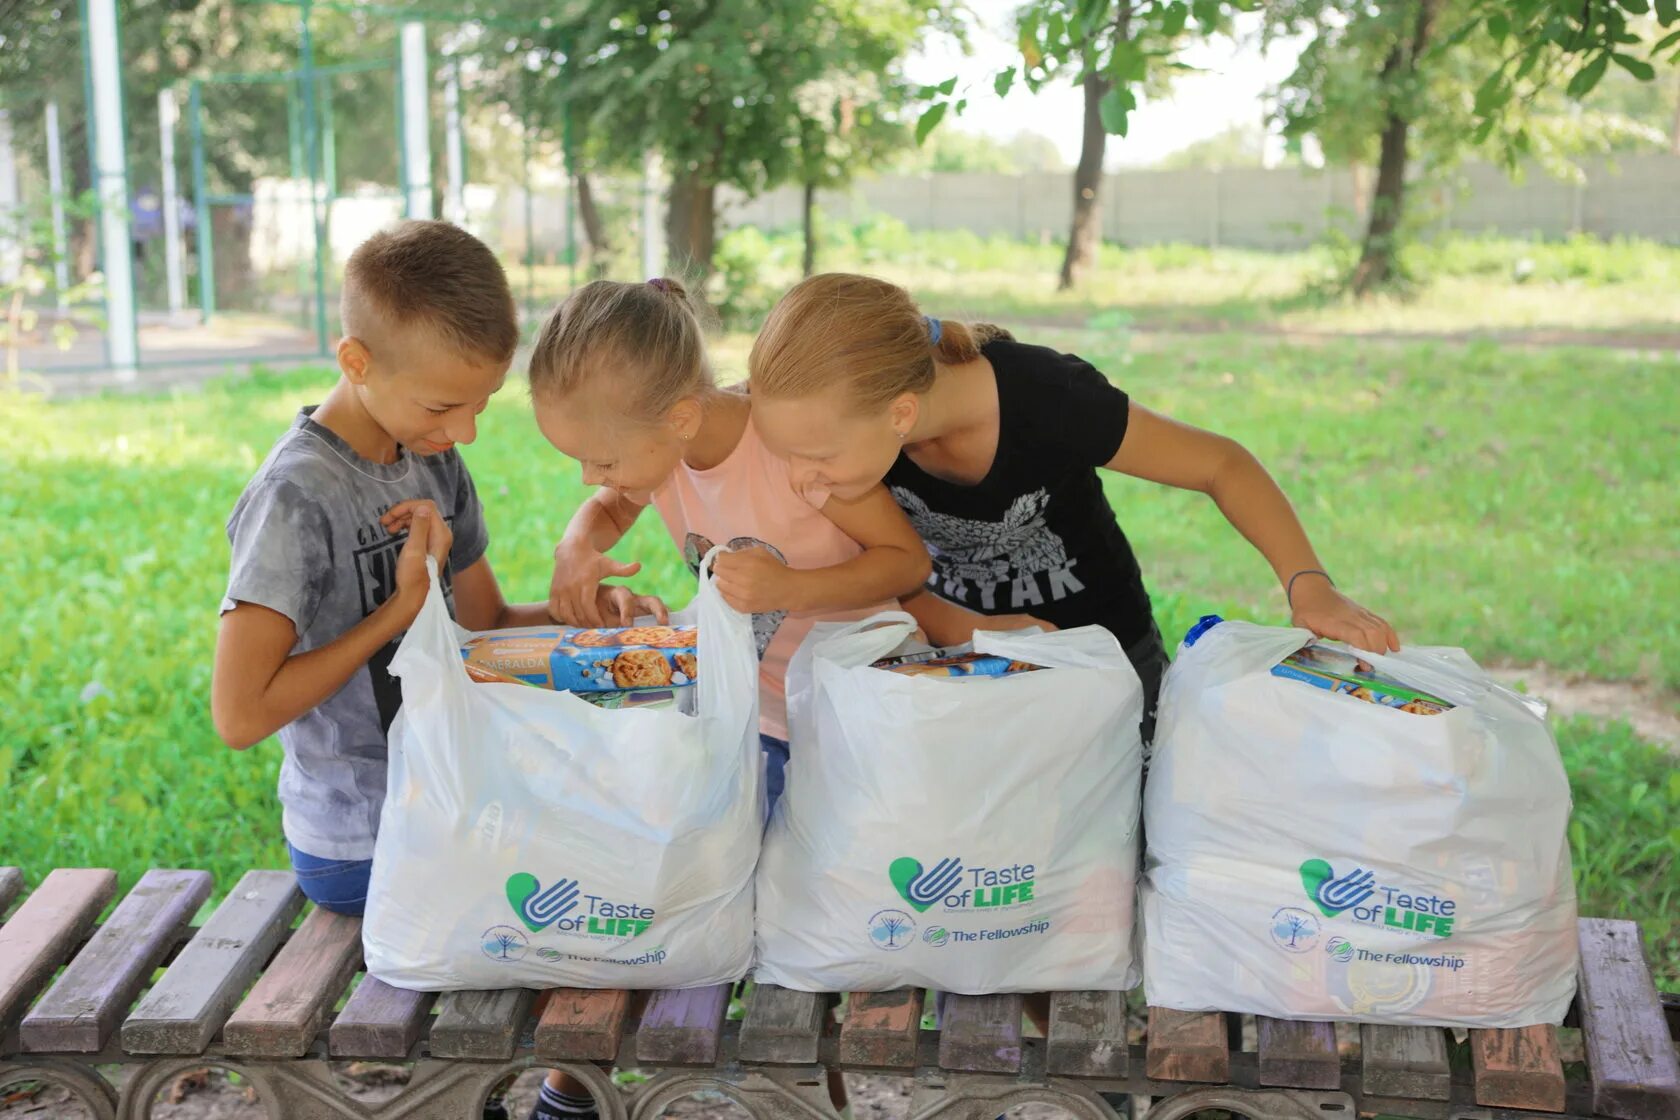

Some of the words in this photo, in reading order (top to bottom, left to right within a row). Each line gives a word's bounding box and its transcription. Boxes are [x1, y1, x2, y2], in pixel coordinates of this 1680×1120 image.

[967, 864, 1035, 887] Taste
[943, 889, 972, 908] of
[973, 880, 1035, 907] LIFE
[1380, 886, 1456, 916] Taste
[584, 895, 655, 919] Taste
[558, 915, 586, 931] of
[952, 930, 977, 942] The
[979, 920, 1050, 941] Fellowship
[1353, 905, 1383, 922] of
[1384, 907, 1455, 938] LIFE
[567, 954, 592, 962] The
[1357, 949, 1383, 962] The
[1385, 953, 1465, 971] Fellowship
